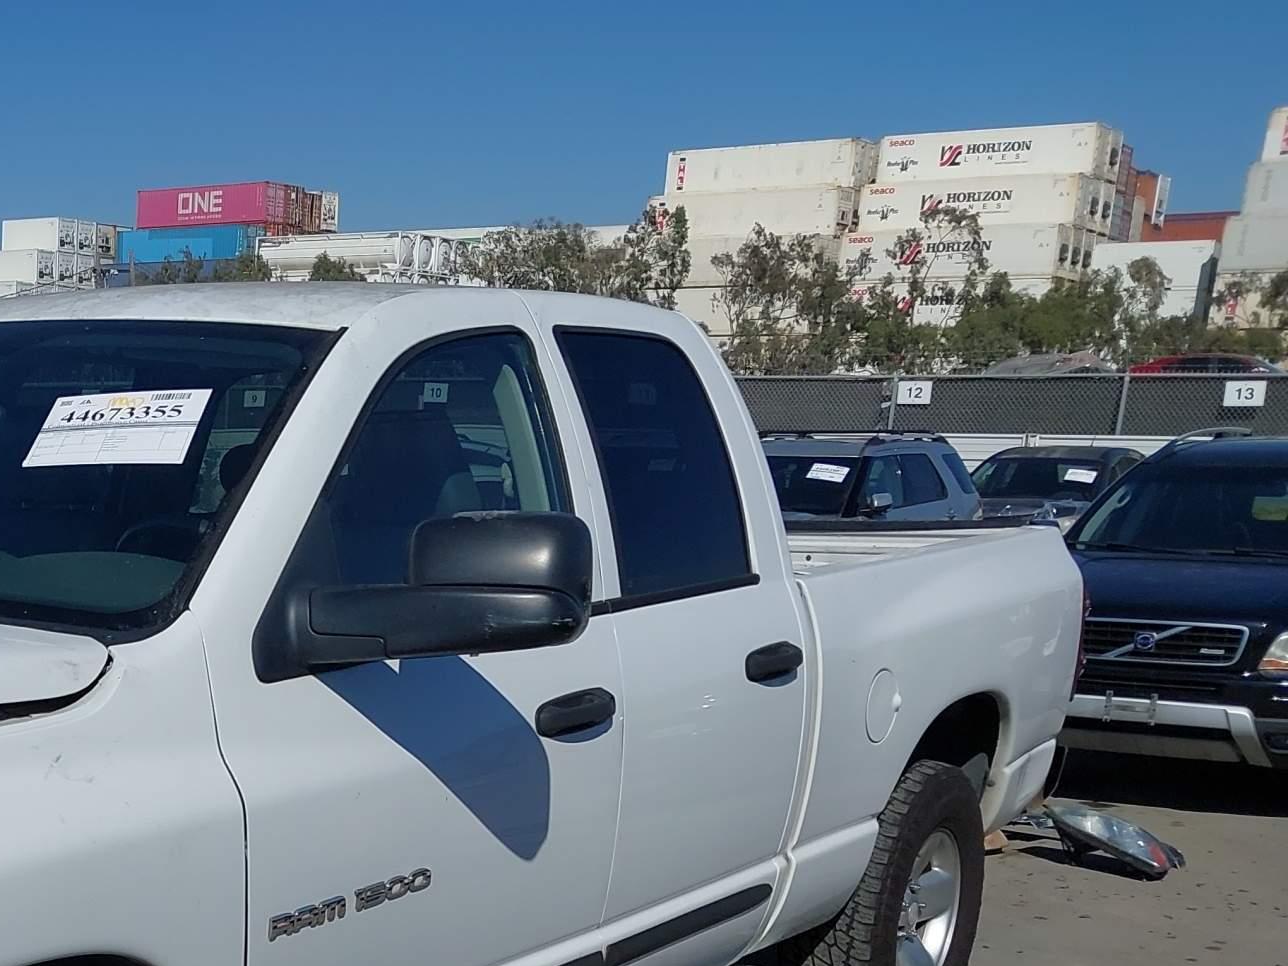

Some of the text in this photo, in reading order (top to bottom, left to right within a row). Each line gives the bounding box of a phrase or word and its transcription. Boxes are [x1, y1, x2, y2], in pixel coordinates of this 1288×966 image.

[889, 138, 915, 148] seaco
[966, 140, 1032, 155] HORIZON
[964, 153, 1021, 163] LINES
[869, 187, 895, 196] seaco
[946, 190, 1014, 204] HORIZON
[178, 190, 223, 214] ONE
[848, 236, 873, 244] seaco
[925, 240, 992, 254] HORIZON
[430, 386, 442, 399] 10
[906, 386, 923, 399] 12
[1235, 388, 1255, 401] 13
[61, 404, 184, 423] 44673355
[354, 867, 432, 912] 1500
